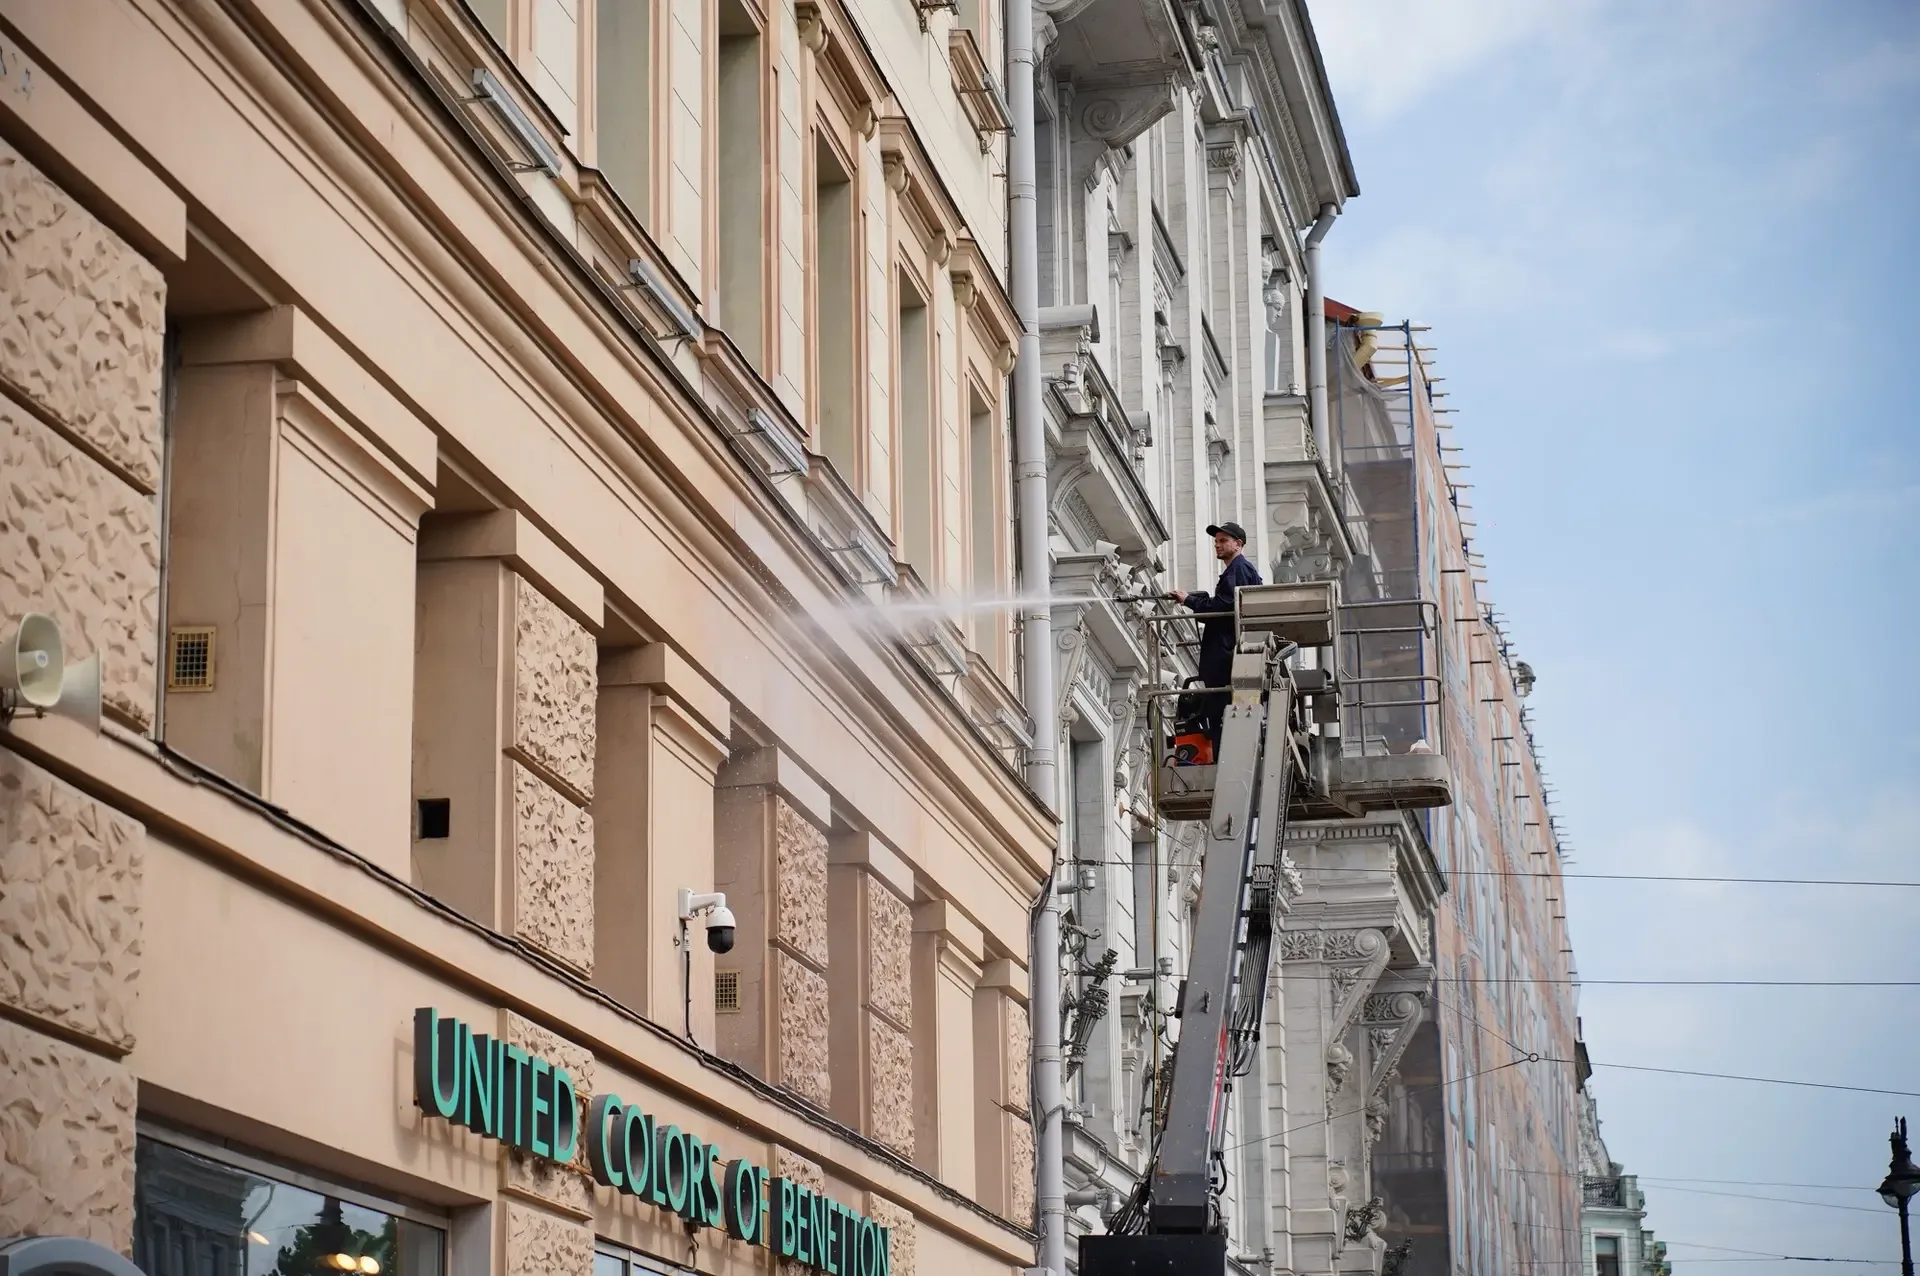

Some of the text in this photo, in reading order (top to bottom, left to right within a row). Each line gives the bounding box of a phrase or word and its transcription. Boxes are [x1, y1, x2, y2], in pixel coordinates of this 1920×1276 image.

[431, 1007, 891, 1276] UNITED COLORS OF BENETTON
